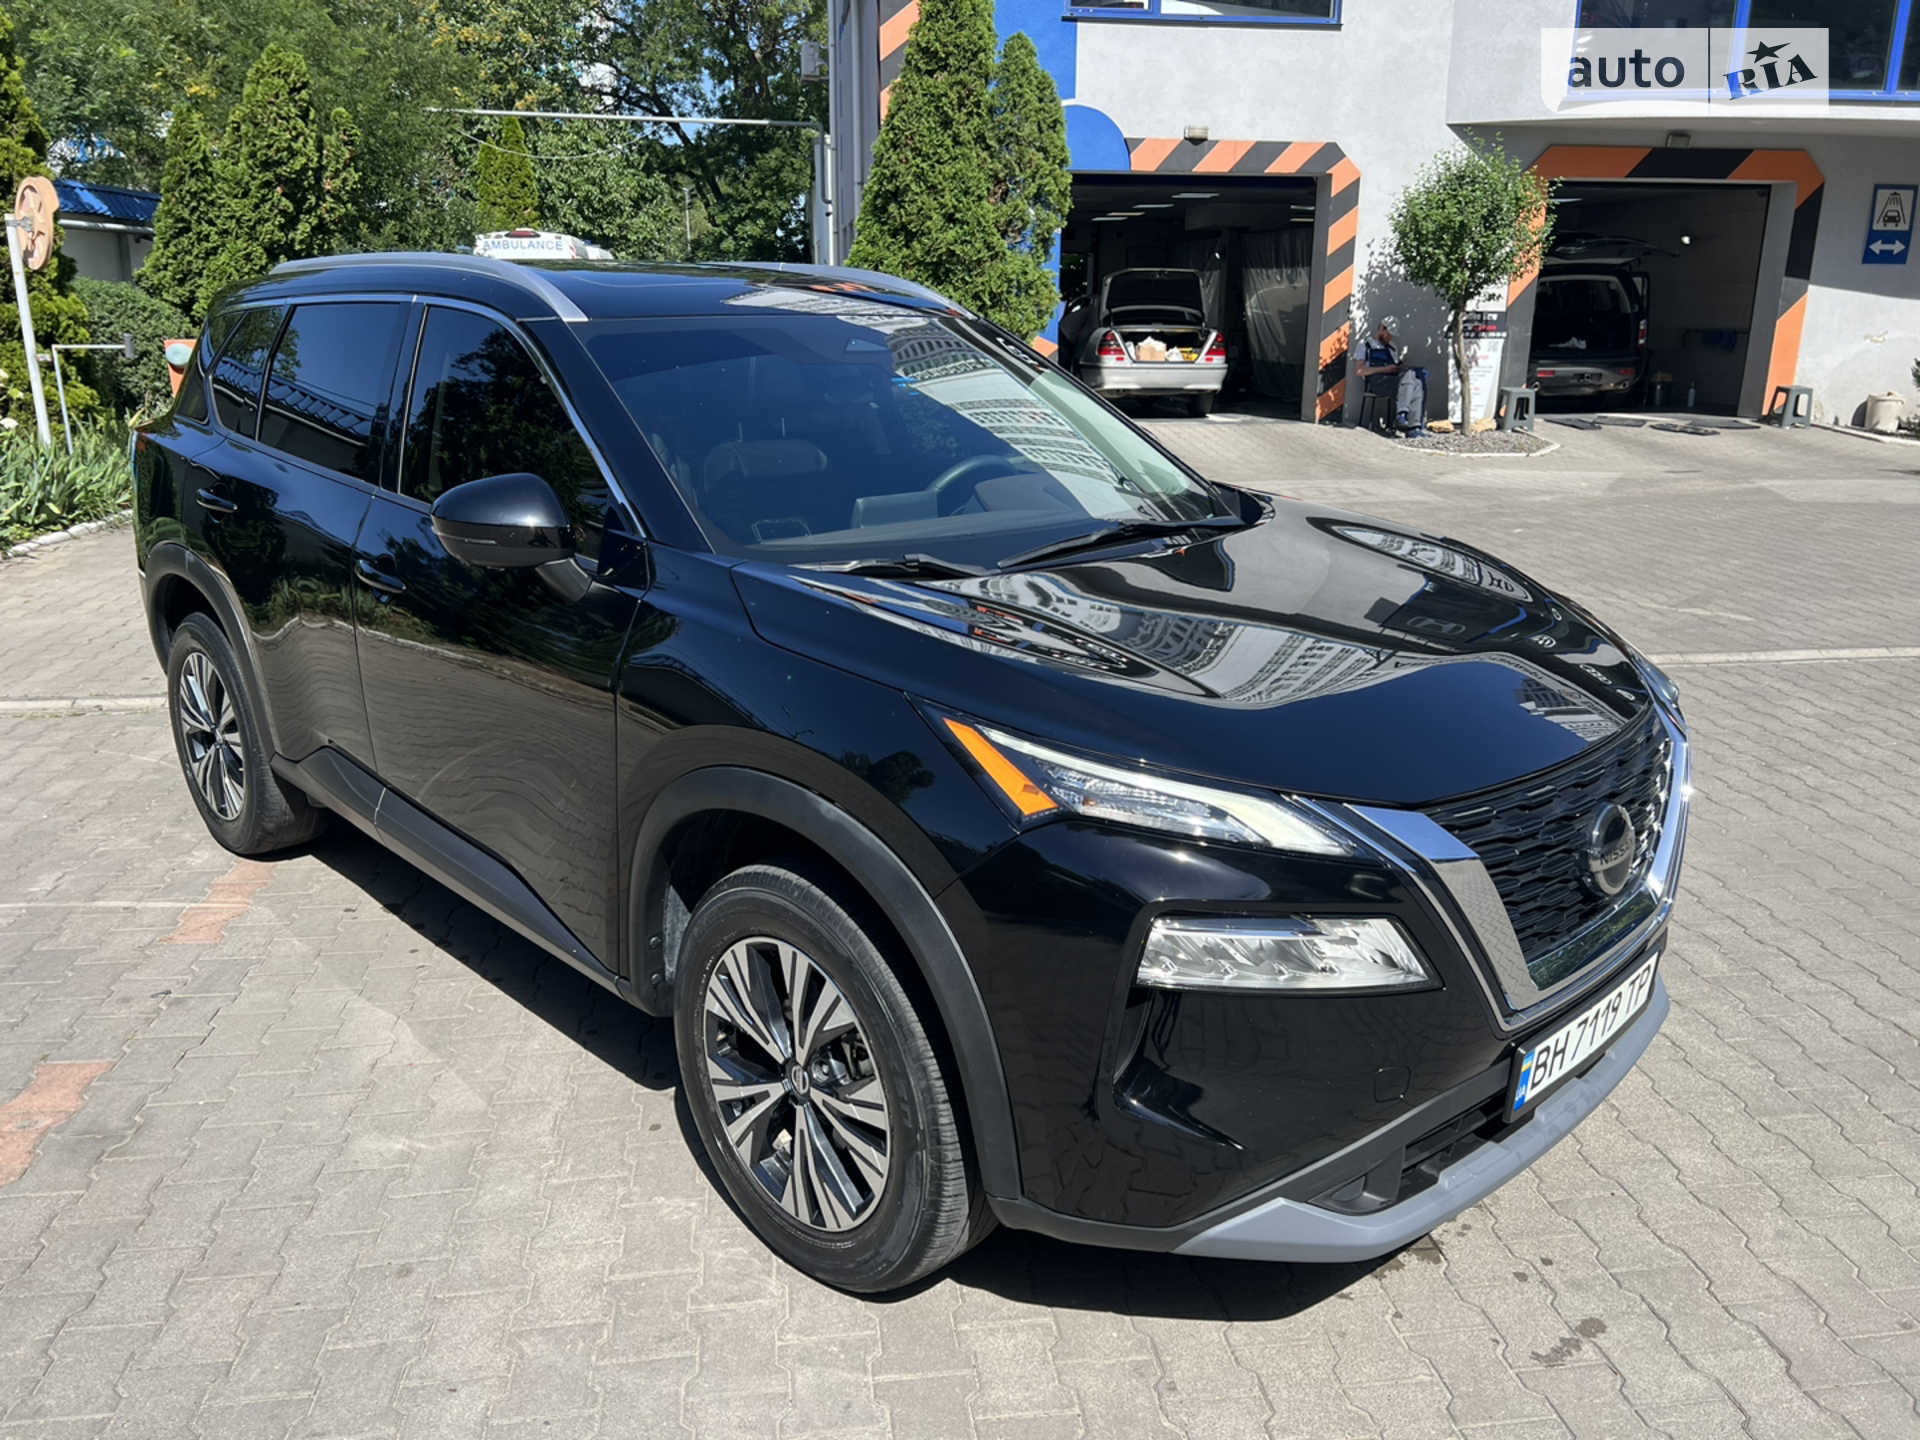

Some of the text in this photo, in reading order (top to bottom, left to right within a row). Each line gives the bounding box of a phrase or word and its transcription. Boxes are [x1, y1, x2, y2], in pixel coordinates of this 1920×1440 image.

[483, 240, 563, 250] AMBULANCE
[1530, 964, 1651, 1090] BH 7119 TP
